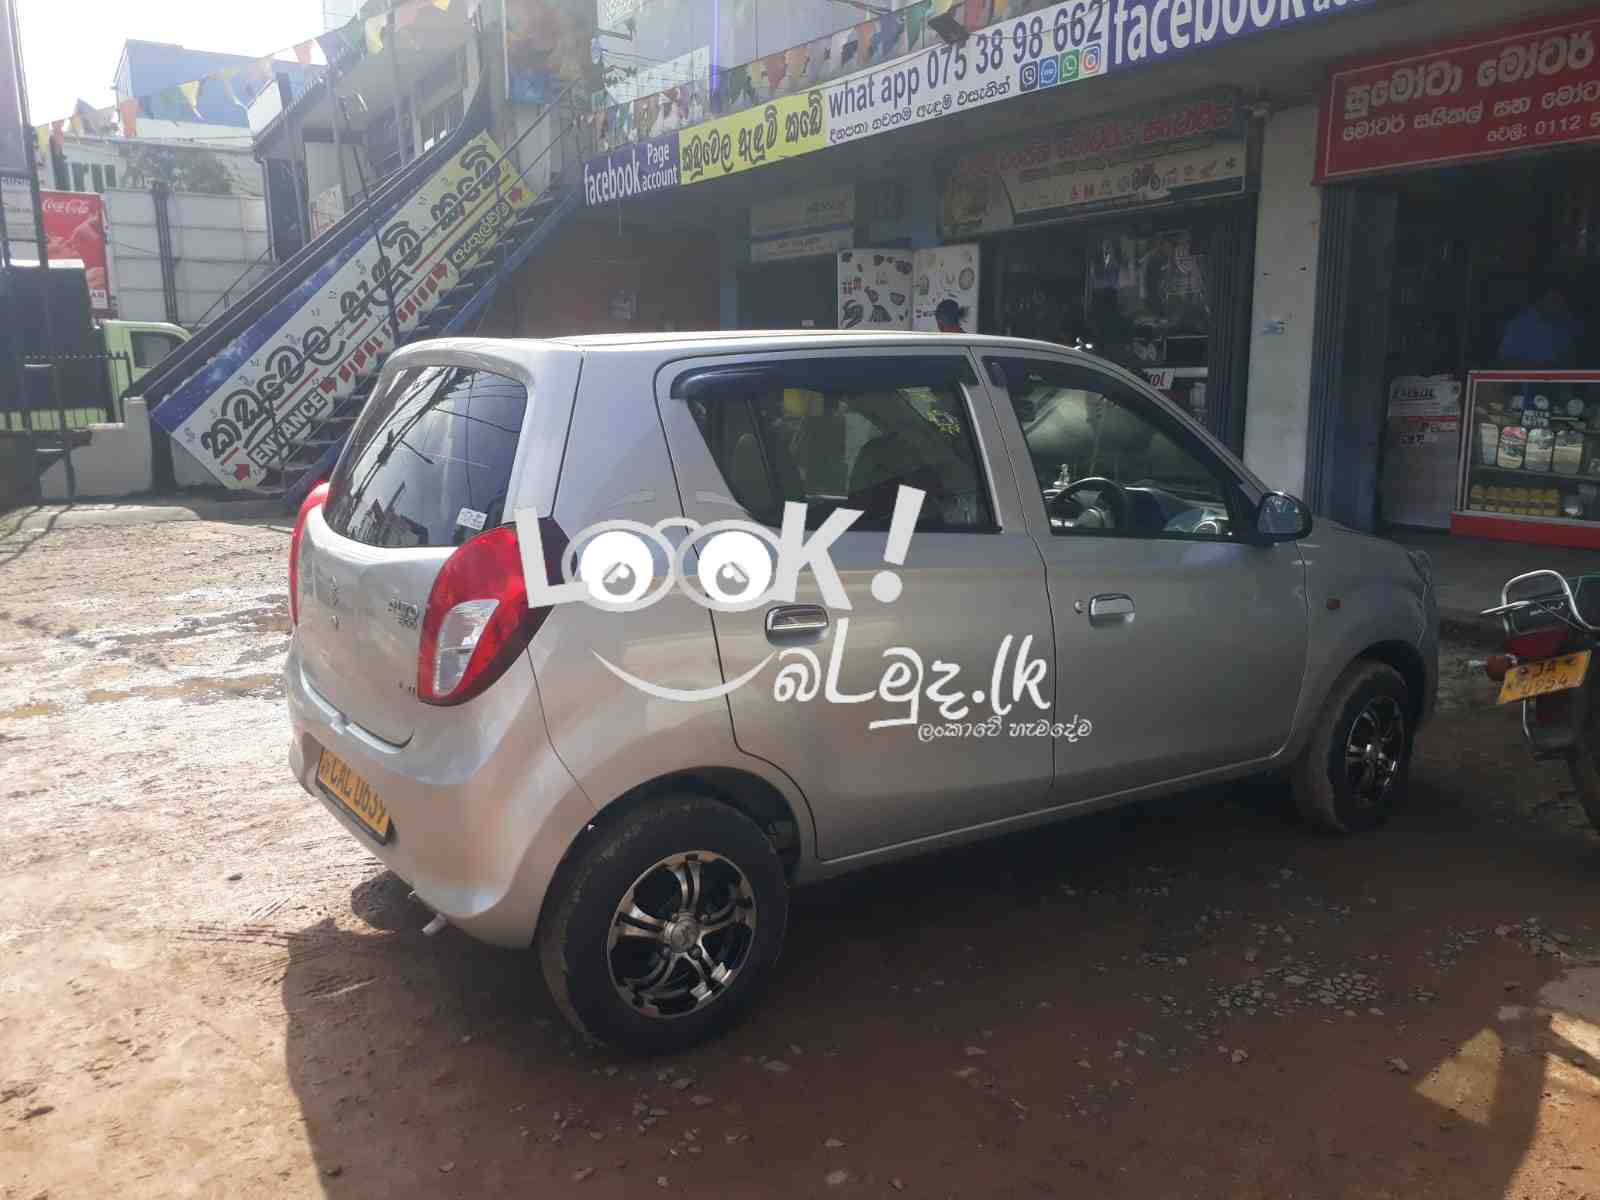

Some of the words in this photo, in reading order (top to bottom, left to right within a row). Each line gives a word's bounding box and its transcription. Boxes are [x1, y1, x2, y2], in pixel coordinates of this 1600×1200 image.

[828, 75, 876, 118] what
[880, 63, 920, 108] app
[926, 38, 968, 90] 075
[974, 28, 1005, 74] 38
[1012, 15, 1044, 64] 98
[1052, 0, 1103, 52] 662
[646, 143, 671, 168] Page
[583, 150, 643, 207] facebook
[642, 166, 679, 192] account
